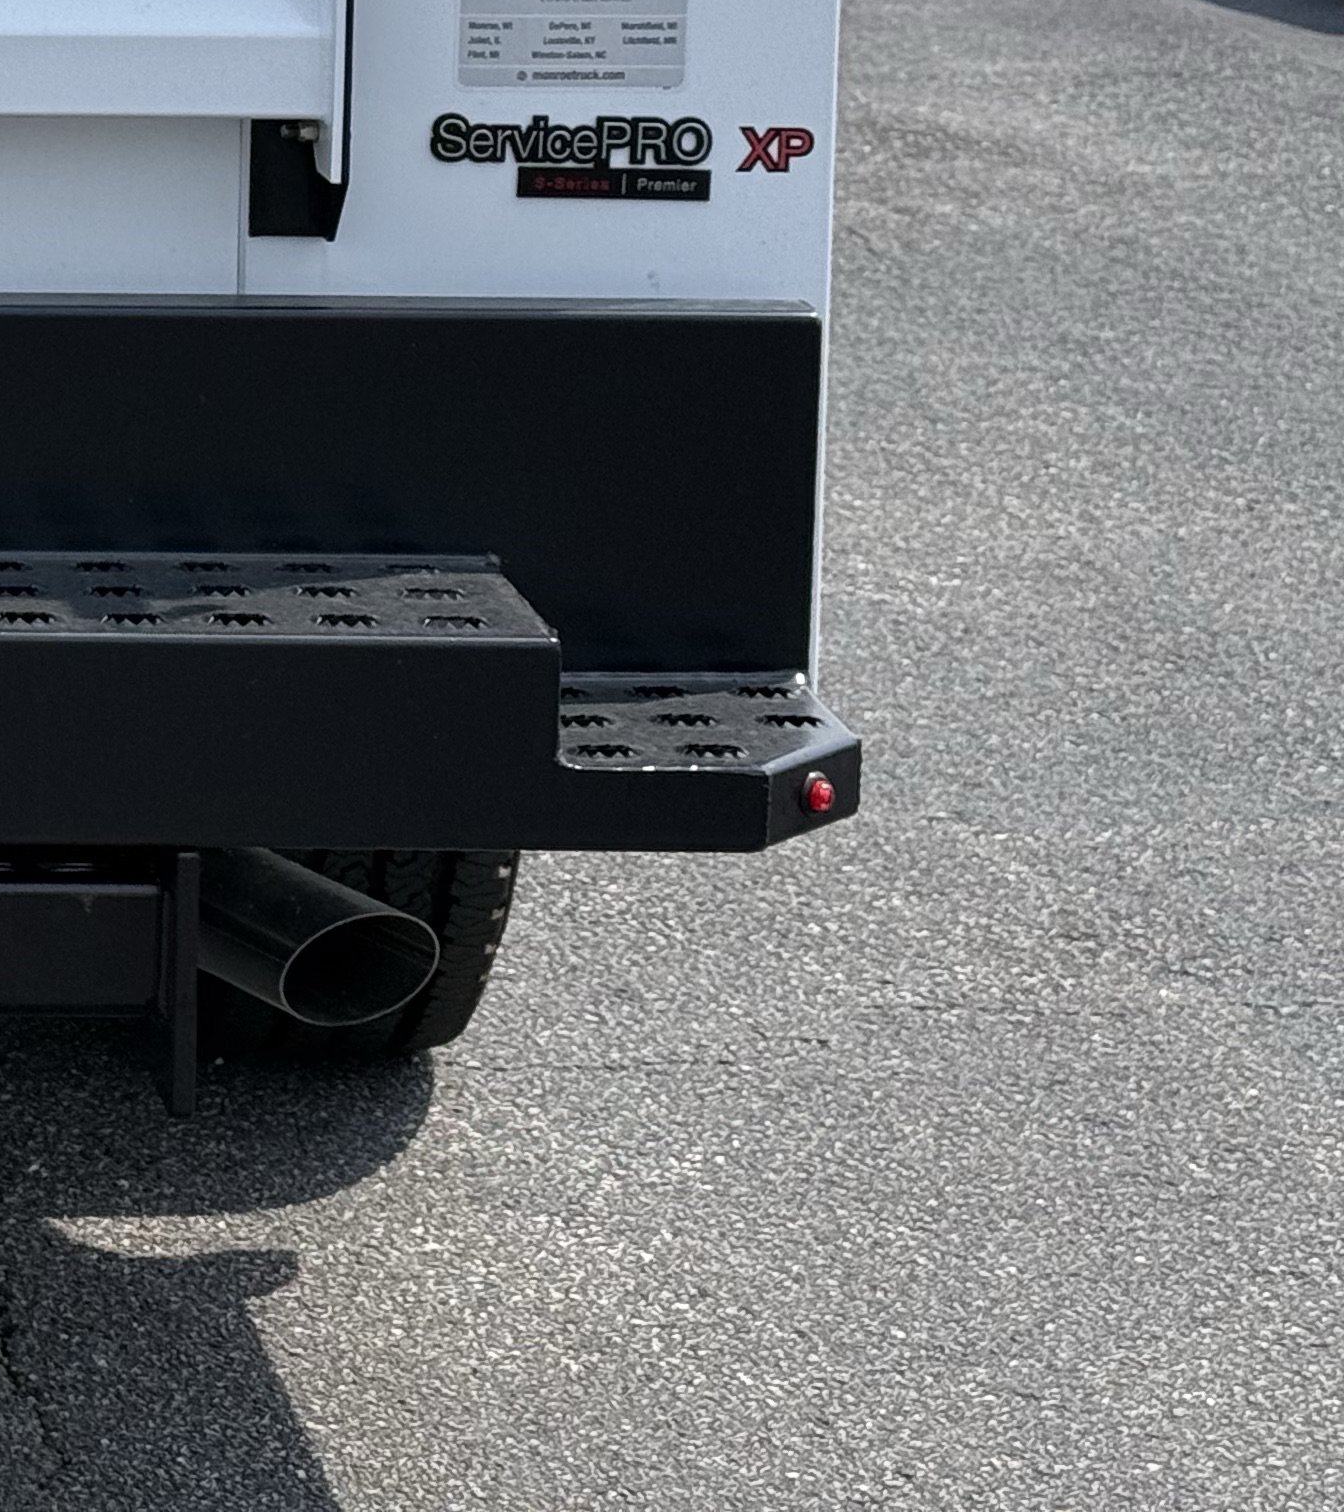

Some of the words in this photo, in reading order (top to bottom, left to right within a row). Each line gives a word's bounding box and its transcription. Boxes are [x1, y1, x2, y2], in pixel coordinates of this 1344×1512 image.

[431, 112, 712, 166] ServicePRO
[736, 126, 815, 173] XP
[637, 177, 698, 194] Premier
